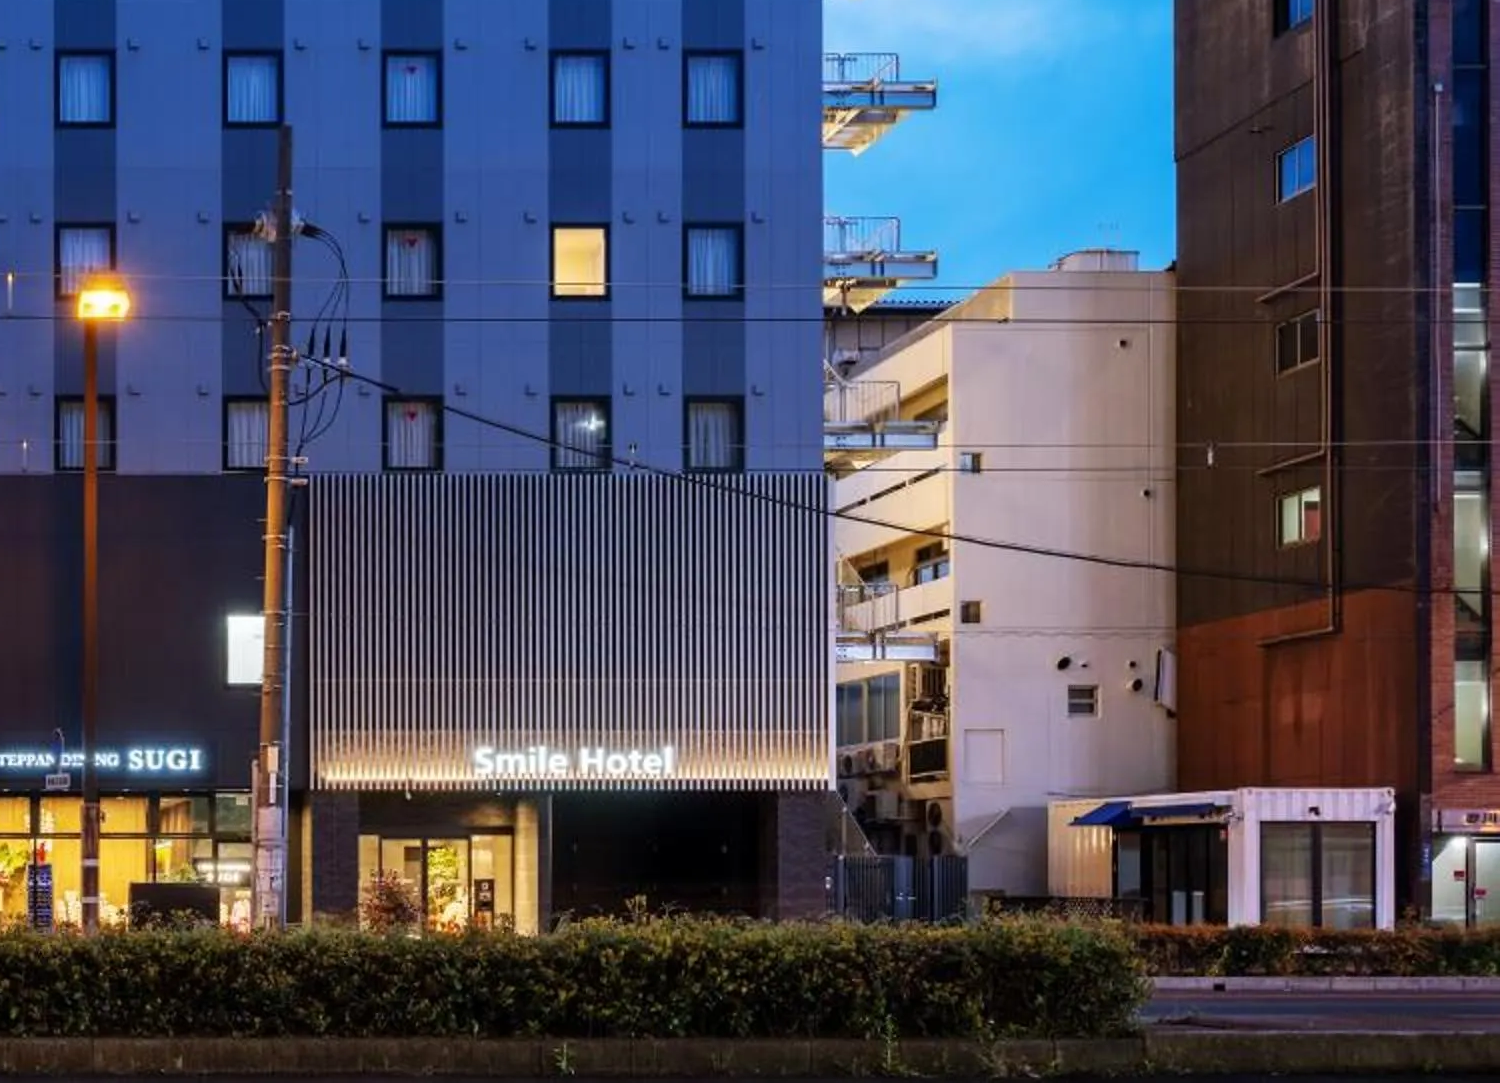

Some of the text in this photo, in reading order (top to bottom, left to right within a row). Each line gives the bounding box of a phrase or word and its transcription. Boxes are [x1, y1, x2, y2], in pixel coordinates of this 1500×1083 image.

[128, 749, 202, 770] SUGI
[475, 746, 674, 774] Smile Hotel
